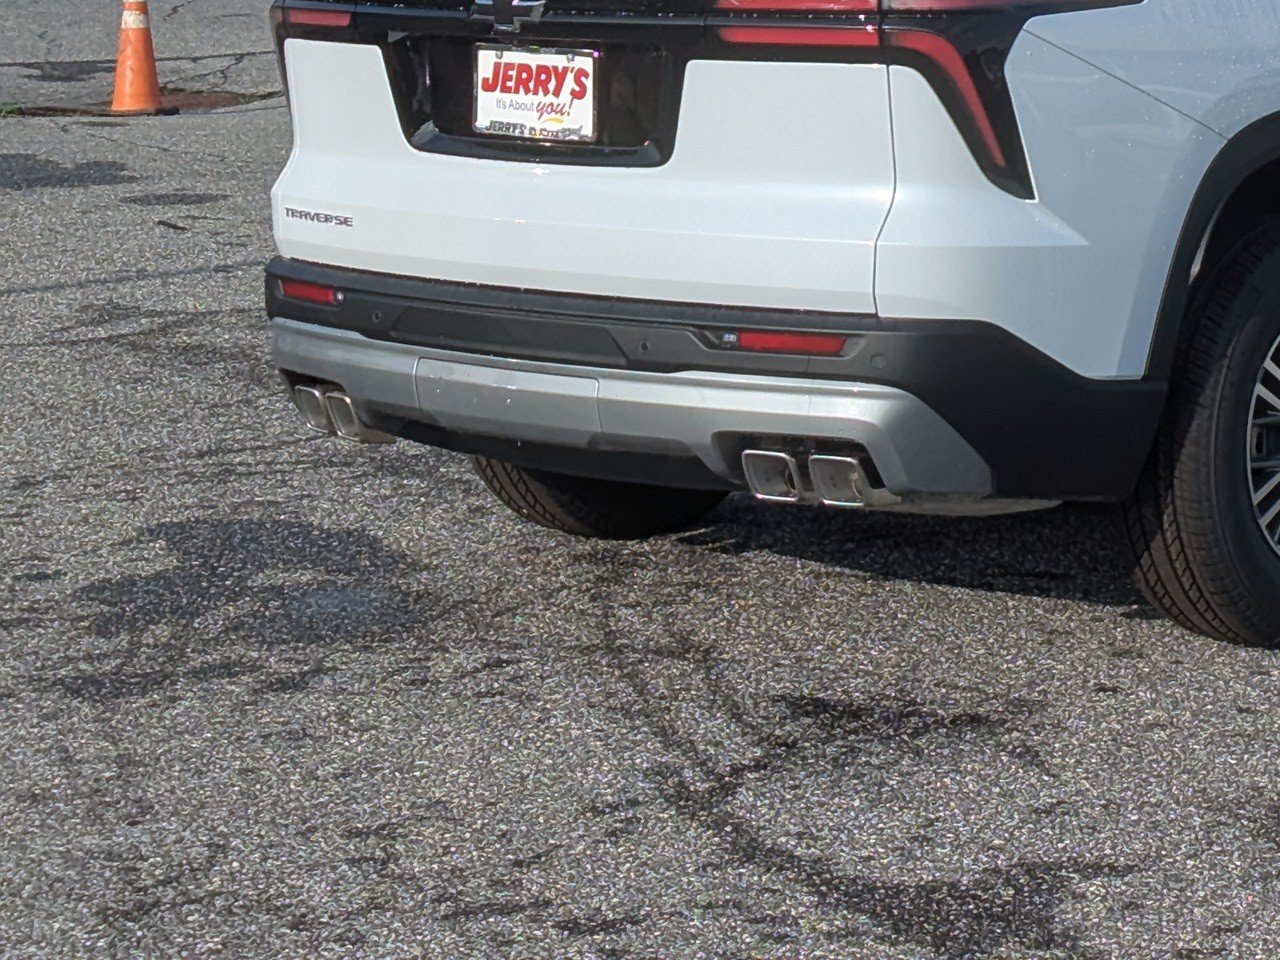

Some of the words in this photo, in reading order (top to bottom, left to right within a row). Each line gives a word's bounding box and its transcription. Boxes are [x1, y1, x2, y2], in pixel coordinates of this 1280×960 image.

[481, 61, 590, 101] JERRY'S
[495, 98, 507, 110] It's
[508, 99, 535, 112] About
[535, 96, 575, 121] you!
[284, 206, 354, 227] TRAVERSE
